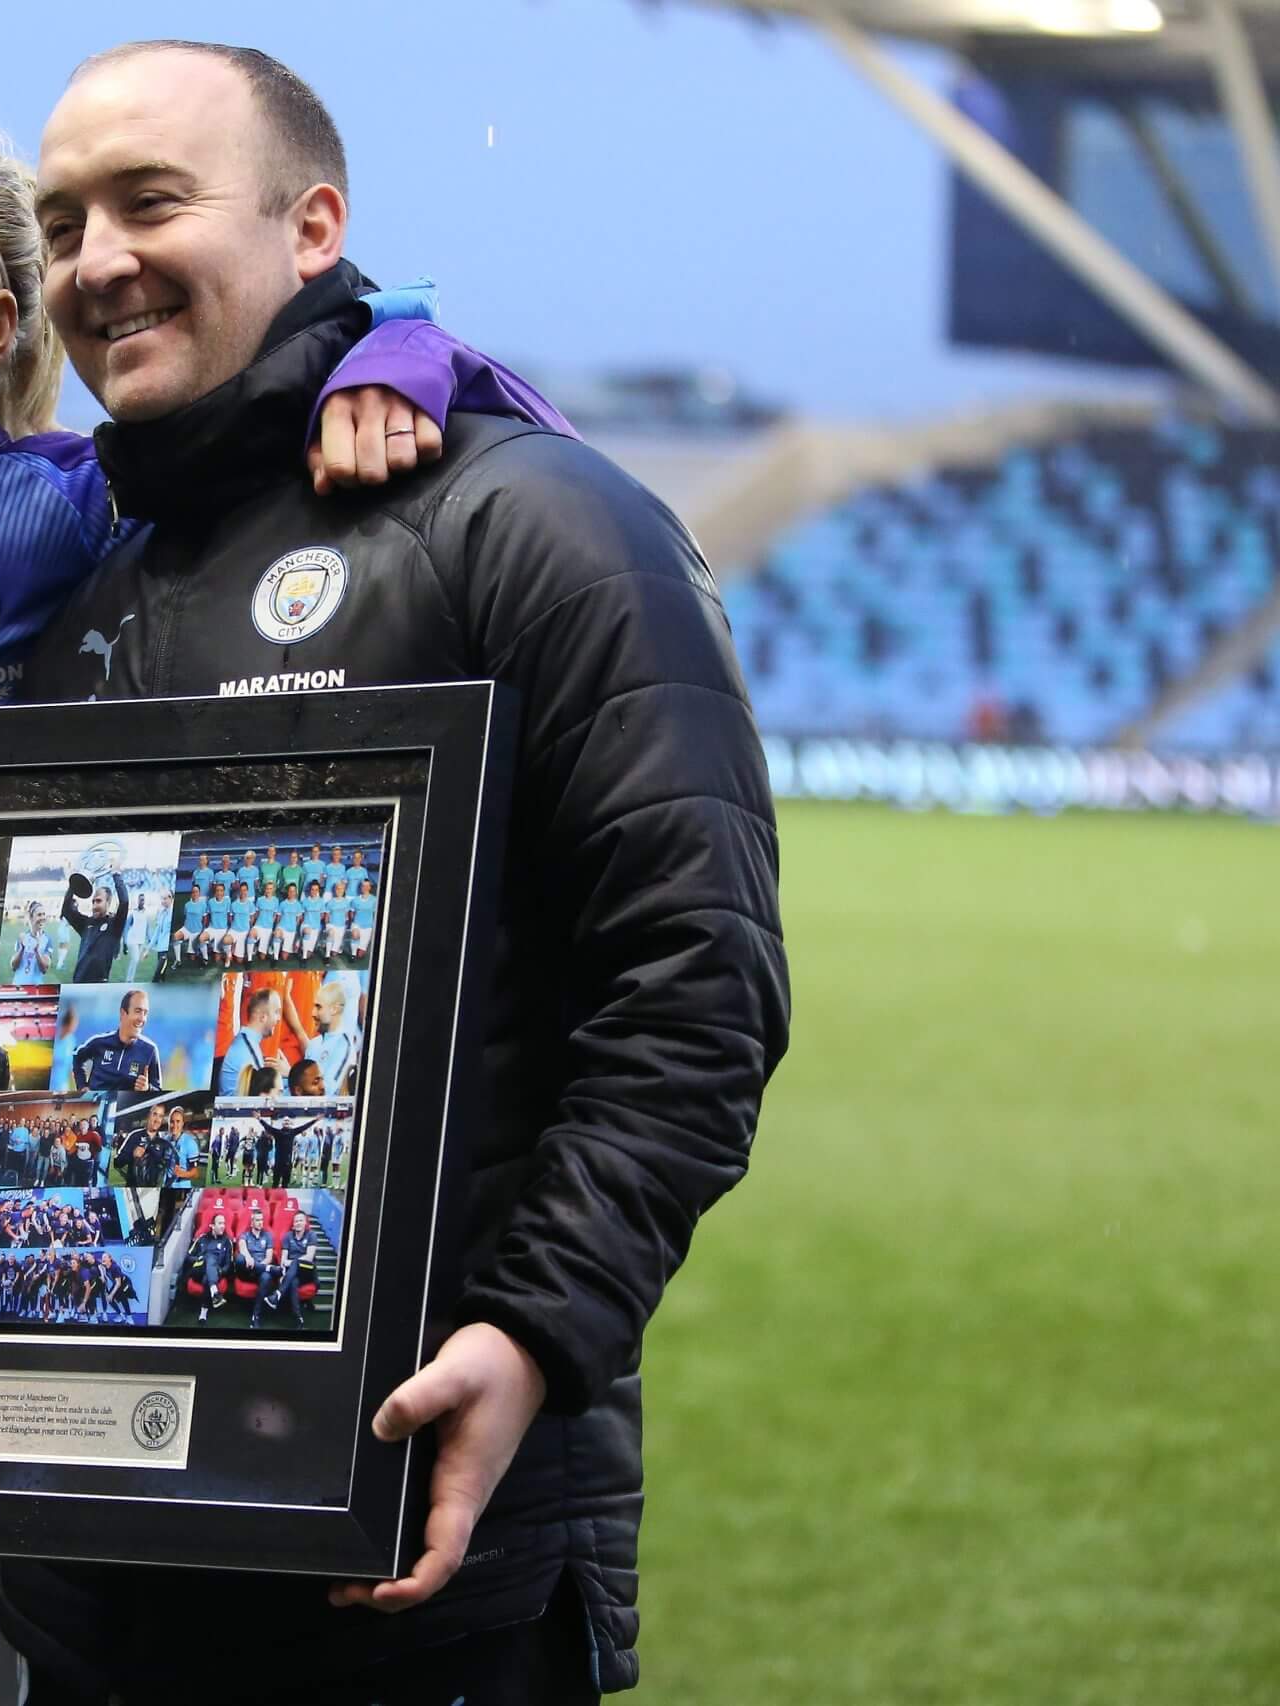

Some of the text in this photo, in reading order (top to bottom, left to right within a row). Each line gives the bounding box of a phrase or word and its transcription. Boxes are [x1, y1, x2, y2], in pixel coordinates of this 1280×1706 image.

[266, 552, 341, 584] MANCHESTER
[277, 625, 306, 638] CITY
[219, 668, 345, 697] MARATHON
[26, 1393, 57, 1402] Manchester
[57, 1394, 70, 1404] City
[55, 1405, 67, 1414] have
[68, 1406, 83, 1414] made
[90, 1406, 100, 1415] the
[69, 1417, 80, 1426] you
[87, 1417, 96, 1425] the
[41, 1428, 55, 1437] your
[55, 1428, 68, 1436] next
[83, 1429, 106, 1439] journey
